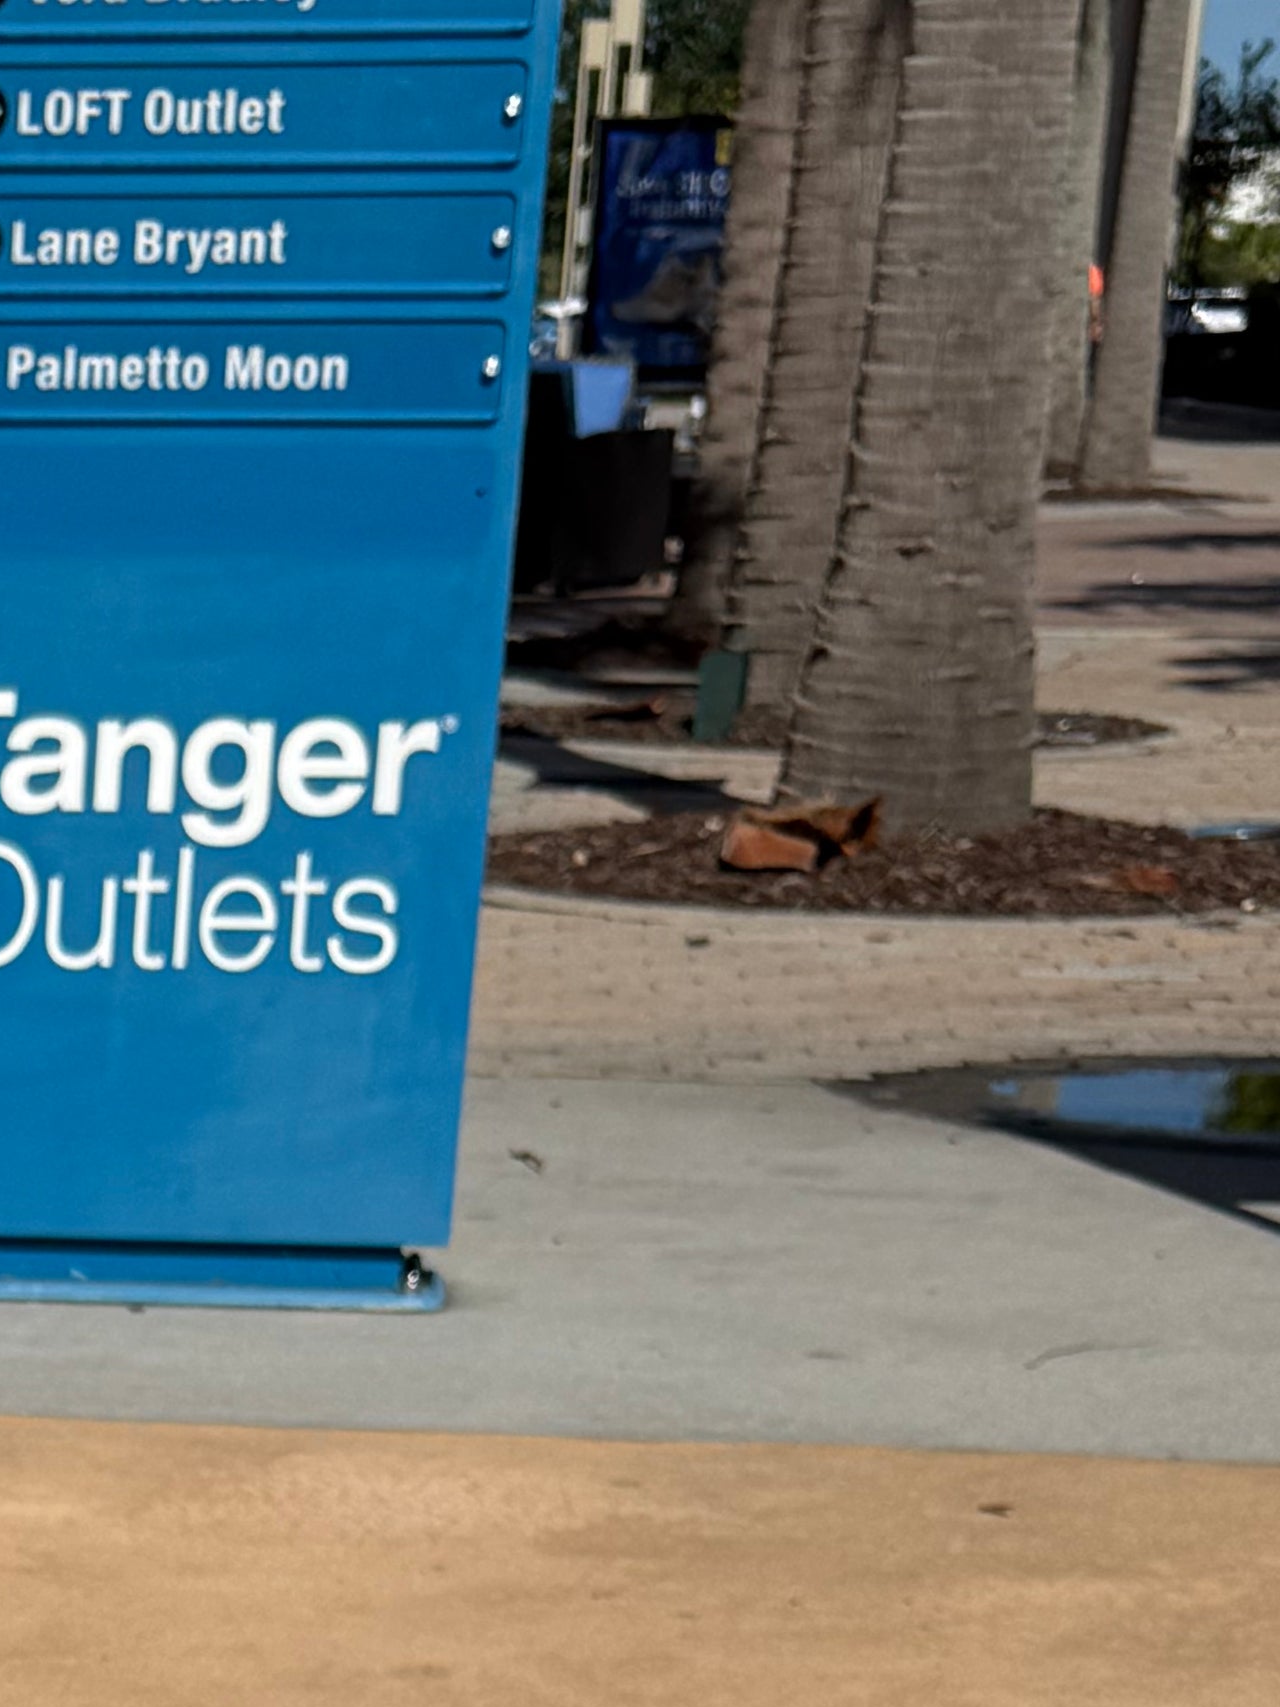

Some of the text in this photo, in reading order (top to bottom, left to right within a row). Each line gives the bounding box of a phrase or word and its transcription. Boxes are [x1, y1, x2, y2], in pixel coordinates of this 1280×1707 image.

[16, 88, 286, 136] LOFT Outlet
[10, 218, 288, 274] Lane Bryant
[7, 345, 349, 391] Palmetto Moon
